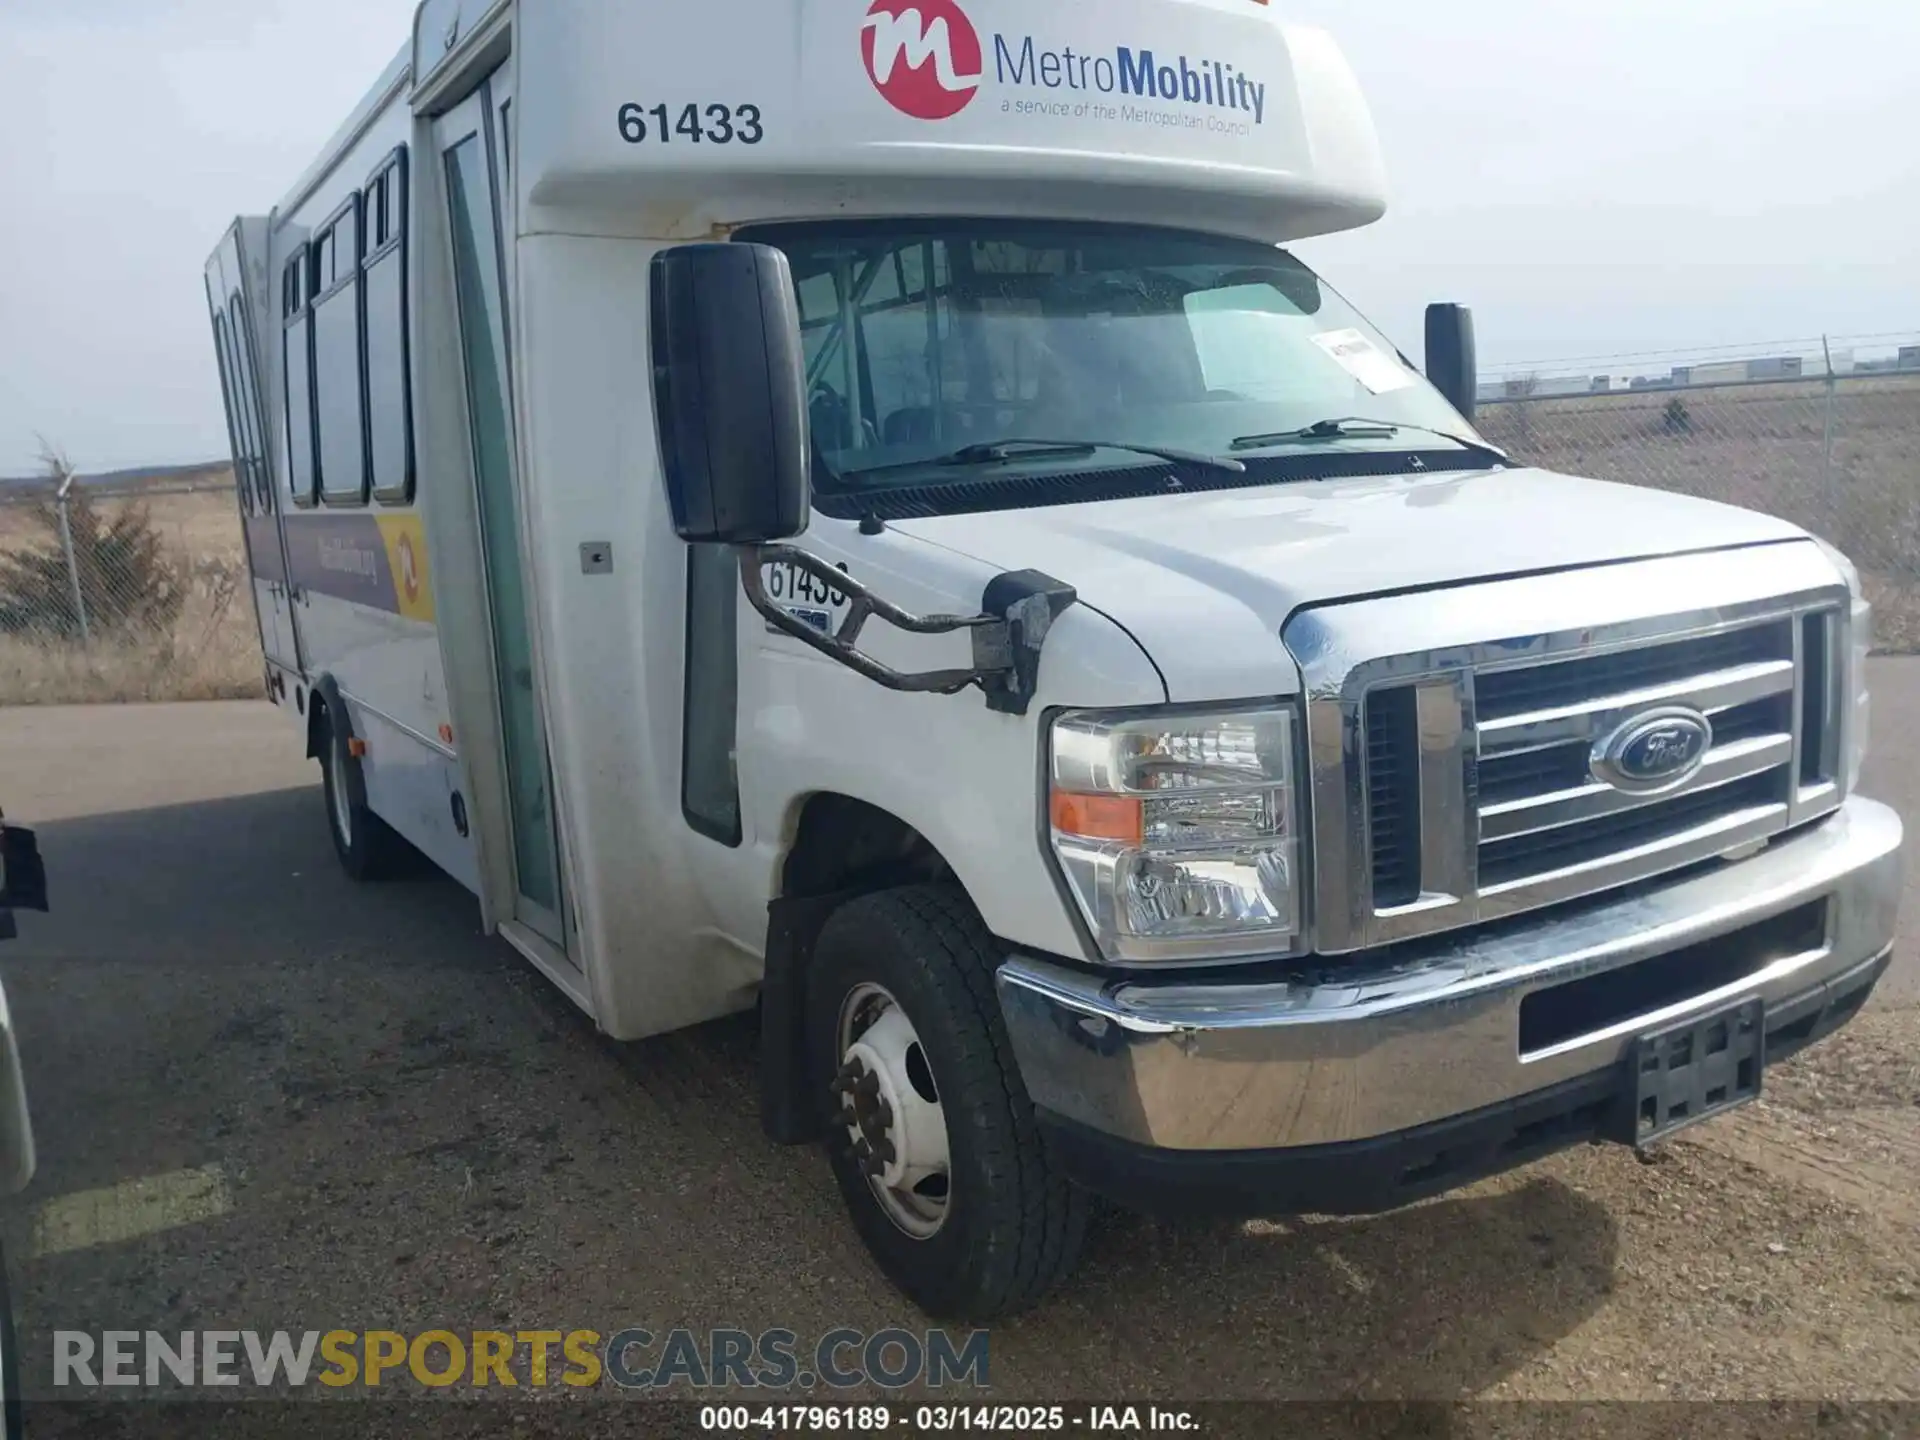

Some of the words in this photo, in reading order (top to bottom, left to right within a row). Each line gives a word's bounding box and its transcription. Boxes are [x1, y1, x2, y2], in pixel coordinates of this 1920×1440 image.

[993, 33, 1264, 124] MetroMobility
[618, 102, 763, 144] 61433
[1001, 99, 1010, 112] a
[1015, 98, 1070, 116] service
[1074, 103, 1090, 117] of
[1093, 104, 1117, 120] the
[1120, 105, 1203, 128] Metropolitan
[1207, 115, 1250, 137] Council
[1642, 730, 1692, 768] Ford
